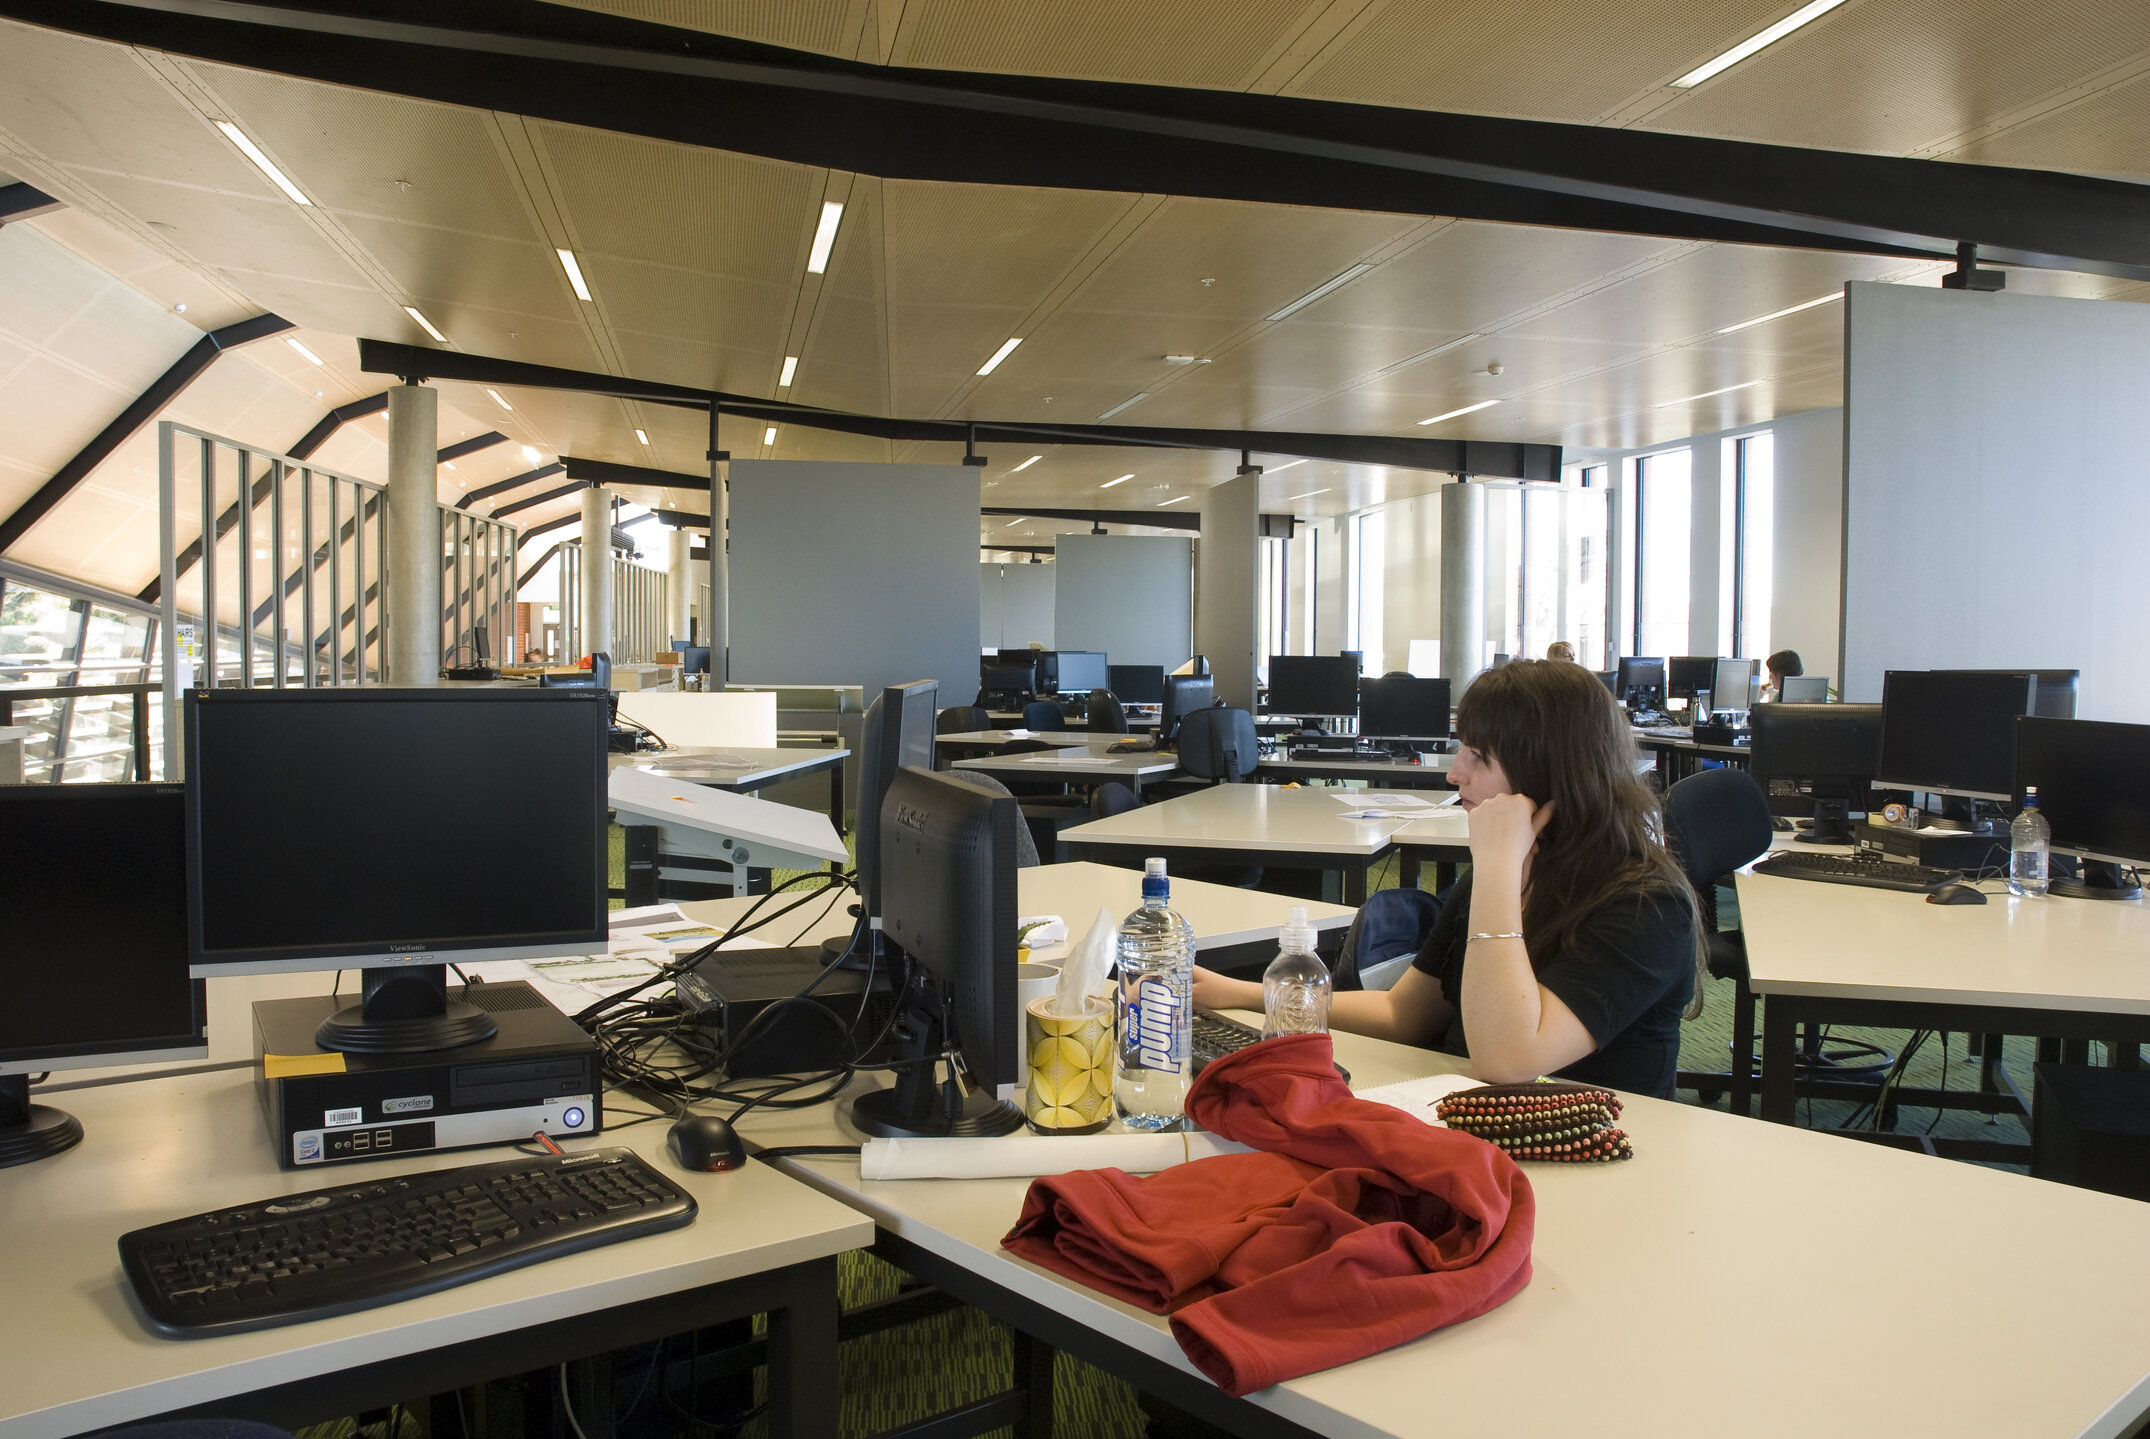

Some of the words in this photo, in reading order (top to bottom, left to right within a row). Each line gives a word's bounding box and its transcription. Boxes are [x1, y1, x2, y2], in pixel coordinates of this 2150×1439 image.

[389, 944, 426, 952] ViewSonic
[1129, 1007, 1139, 1041] super
[1139, 980, 1181, 1074] pump
[398, 1098, 432, 1109] cyclone
[561, 1153, 600, 1165] Microsoft
